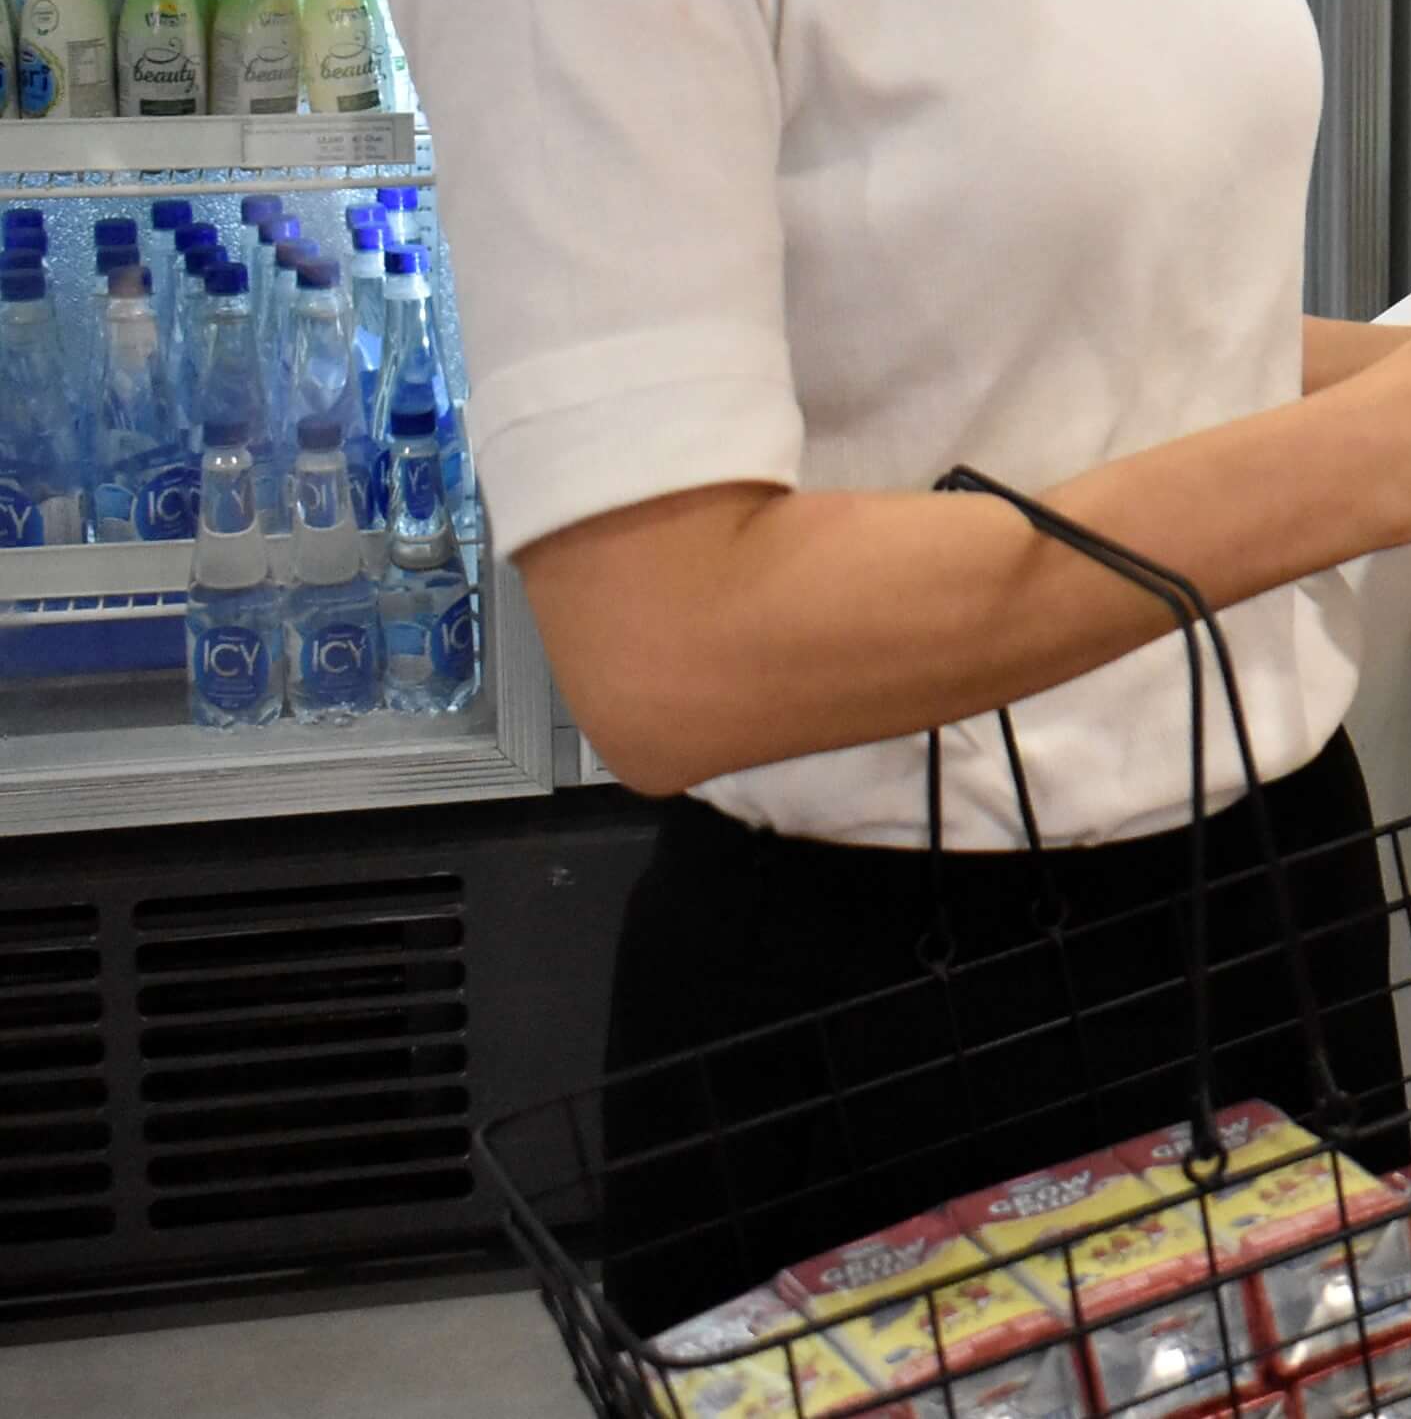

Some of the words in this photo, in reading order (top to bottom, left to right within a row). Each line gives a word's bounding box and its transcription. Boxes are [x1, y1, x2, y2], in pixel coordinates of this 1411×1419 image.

[134, 56, 197, 93] beauty
[244, 58, 298, 83] beau
[442, 616, 473, 649] IC
[203, 641, 260, 678] ICY
[312, 639, 367, 675] ICY
